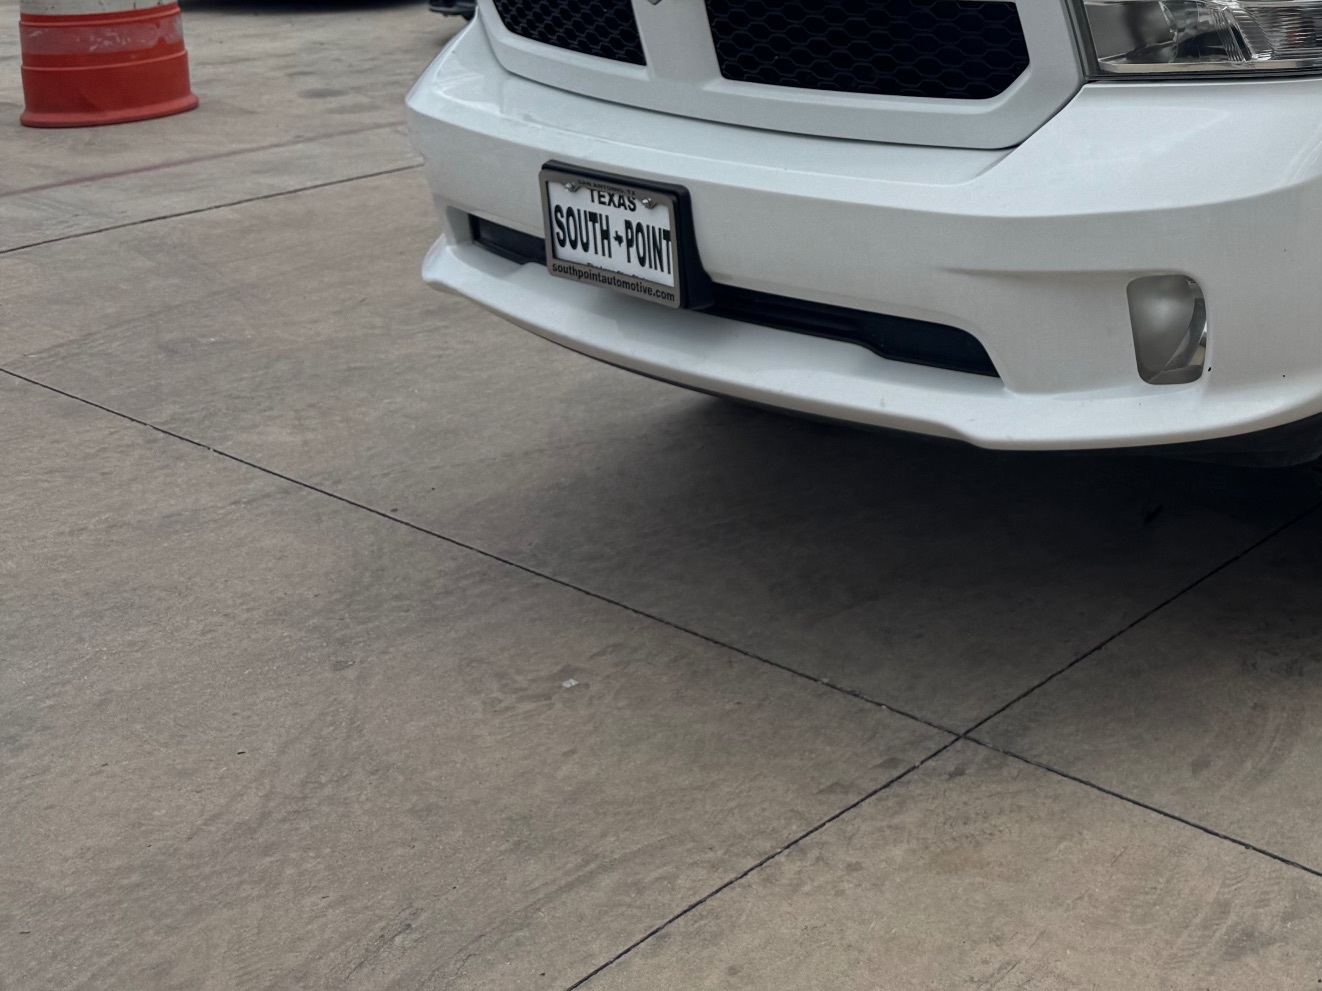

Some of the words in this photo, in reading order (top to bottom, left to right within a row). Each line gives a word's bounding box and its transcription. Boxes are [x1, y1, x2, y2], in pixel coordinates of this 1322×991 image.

[590, 189, 637, 212] TEXAS
[554, 204, 612, 259] SOUTH
[624, 219, 672, 275] POINT
[552, 263, 675, 302] southpointautomotive.com
